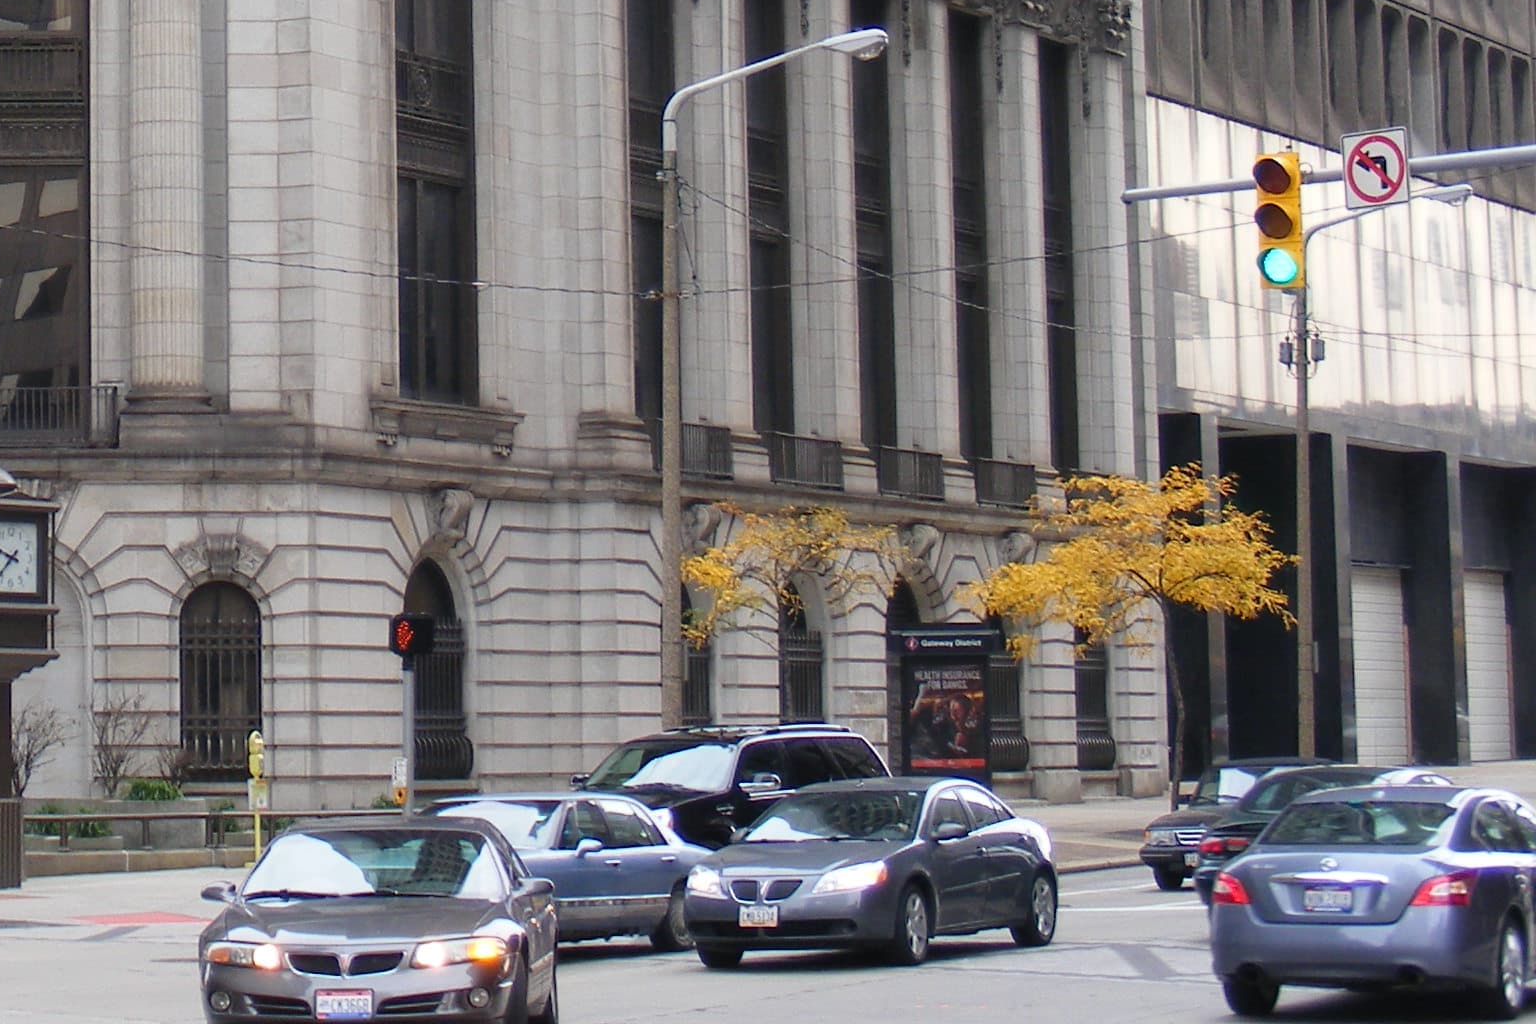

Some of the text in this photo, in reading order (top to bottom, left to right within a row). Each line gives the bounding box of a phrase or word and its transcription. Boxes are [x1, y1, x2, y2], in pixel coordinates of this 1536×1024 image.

[921, 638, 982, 648] Gateway District
[914, 670, 982, 680] HEALTH INSURANCE
